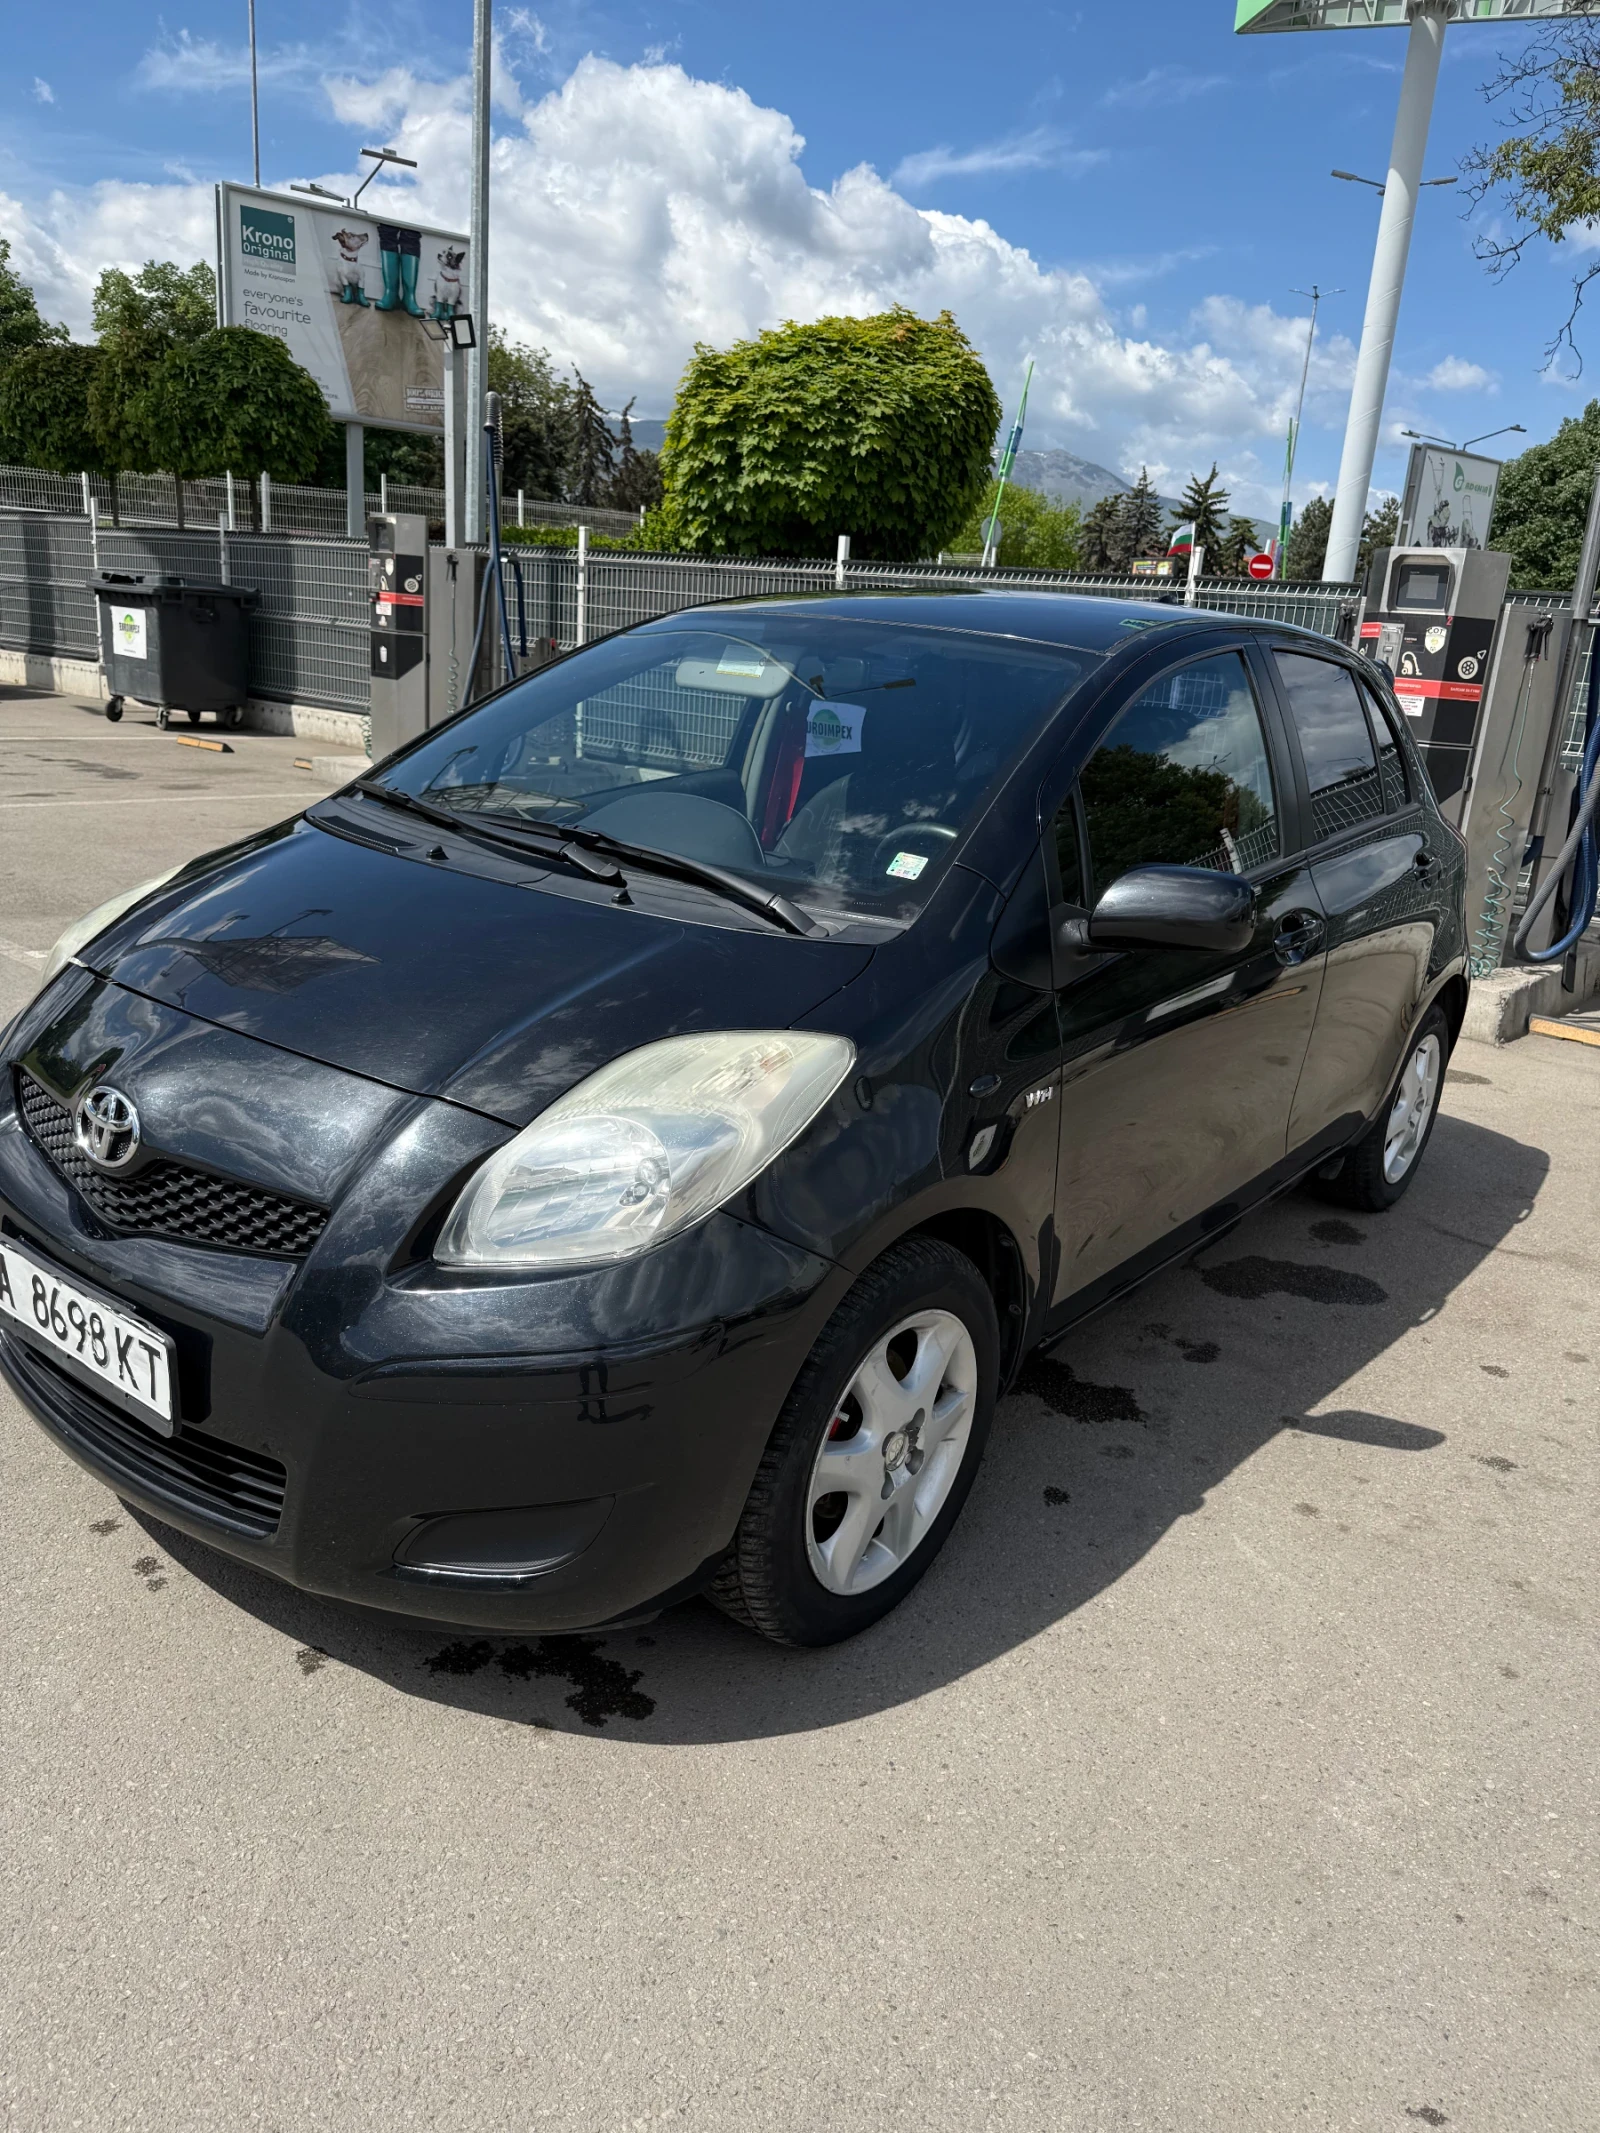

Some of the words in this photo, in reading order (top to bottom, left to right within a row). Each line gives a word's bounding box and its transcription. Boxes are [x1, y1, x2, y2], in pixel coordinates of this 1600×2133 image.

[242, 225, 294, 249] Krono
[243, 242, 294, 261] Original
[244, 268, 260, 277] Made
[260, 271, 268, 279] by
[243, 288, 304, 307] everyone's
[243, 300, 311, 324] favourite
[244, 318, 288, 337] flooring
[1446, 616, 1454, 626] 2
[806, 721, 853, 740] UROIMPEX
